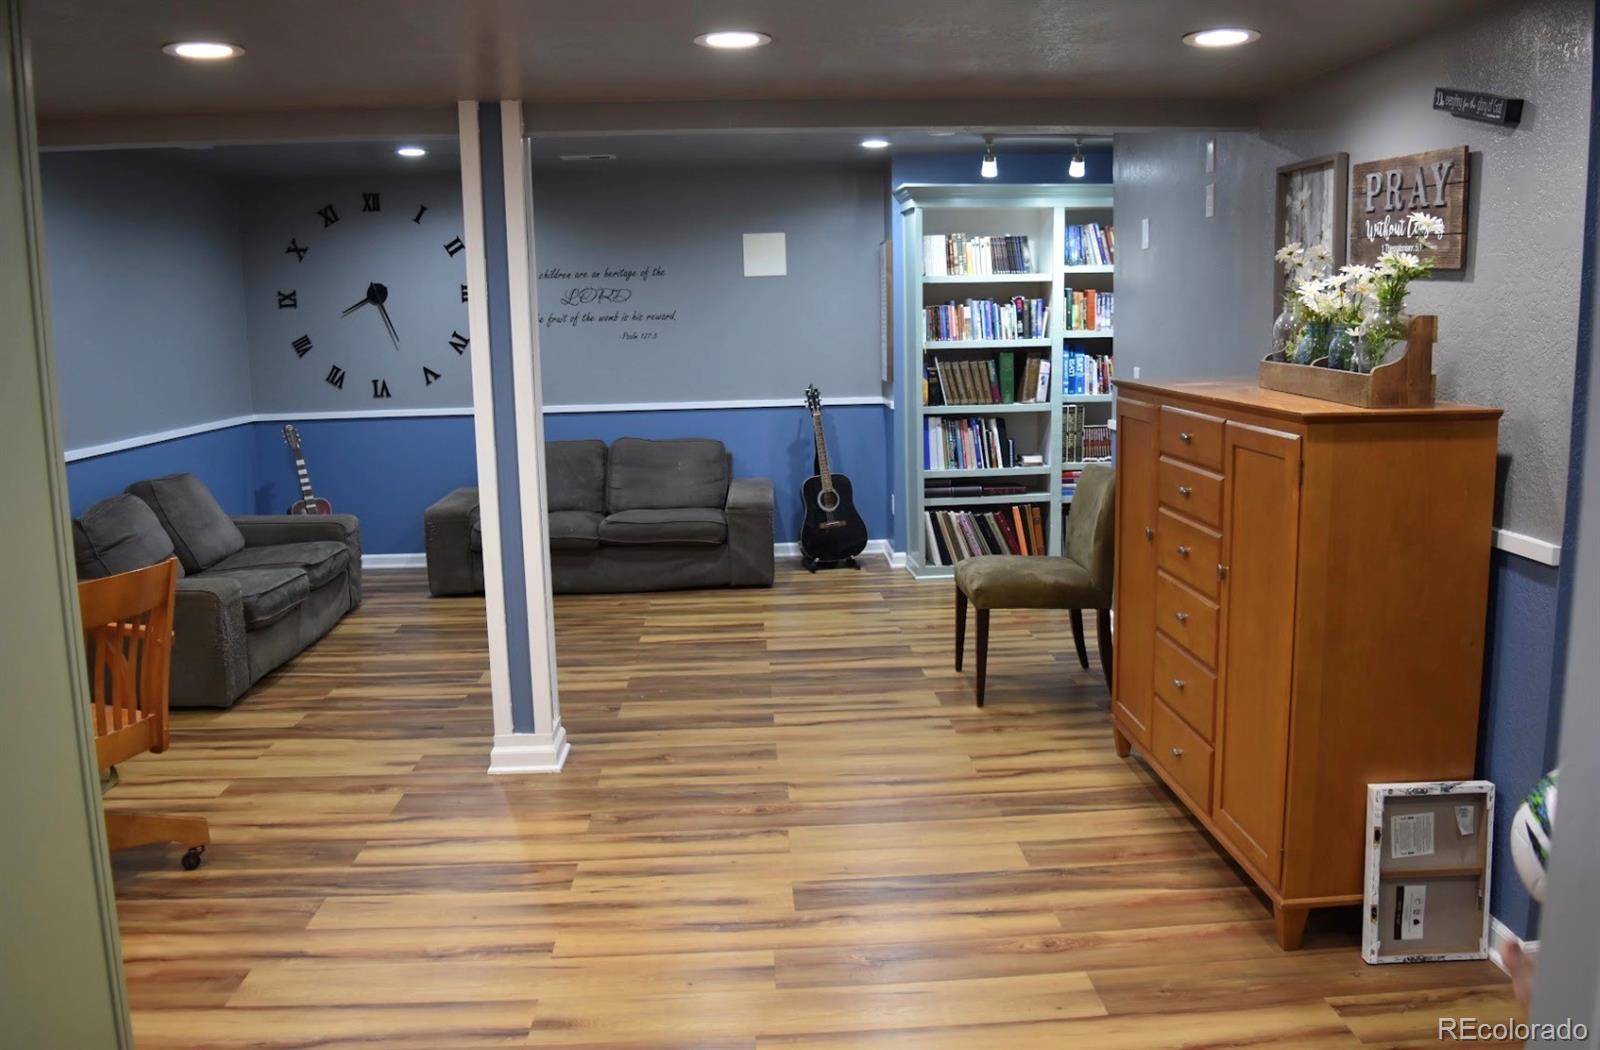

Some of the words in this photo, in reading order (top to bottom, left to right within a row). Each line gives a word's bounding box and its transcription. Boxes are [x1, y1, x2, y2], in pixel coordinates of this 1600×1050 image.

[1365, 159, 1455, 213] PRAY
[362, 193, 380, 212] XII
[317, 204, 340, 229] XI
[412, 204, 428, 224] I
[1366, 214, 1406, 242] Without
[285, 238, 309, 263] X
[443, 236, 465, 258] II
[538, 267, 571, 280] children
[575, 271, 589, 279] are
[591, 271, 601, 279] an
[603, 266, 637, 281] heritage
[640, 265, 650, 281] of
[651, 265, 666, 277] the
[278, 290, 297, 309] IX
[560, 288, 632, 306] LORD
[546, 311, 569, 328] fruit
[570, 311, 580, 327] of
[582, 311, 595, 322] the
[598, 311, 619, 322] womb
[621, 312, 629, 321] is
[631, 310, 644, 321] his
[292, 334, 314, 359] VIII
[448, 331, 470, 355] IV
[326, 365, 346, 390] VII
[423, 366, 441, 386] V
[372, 379, 392, 398] VI
